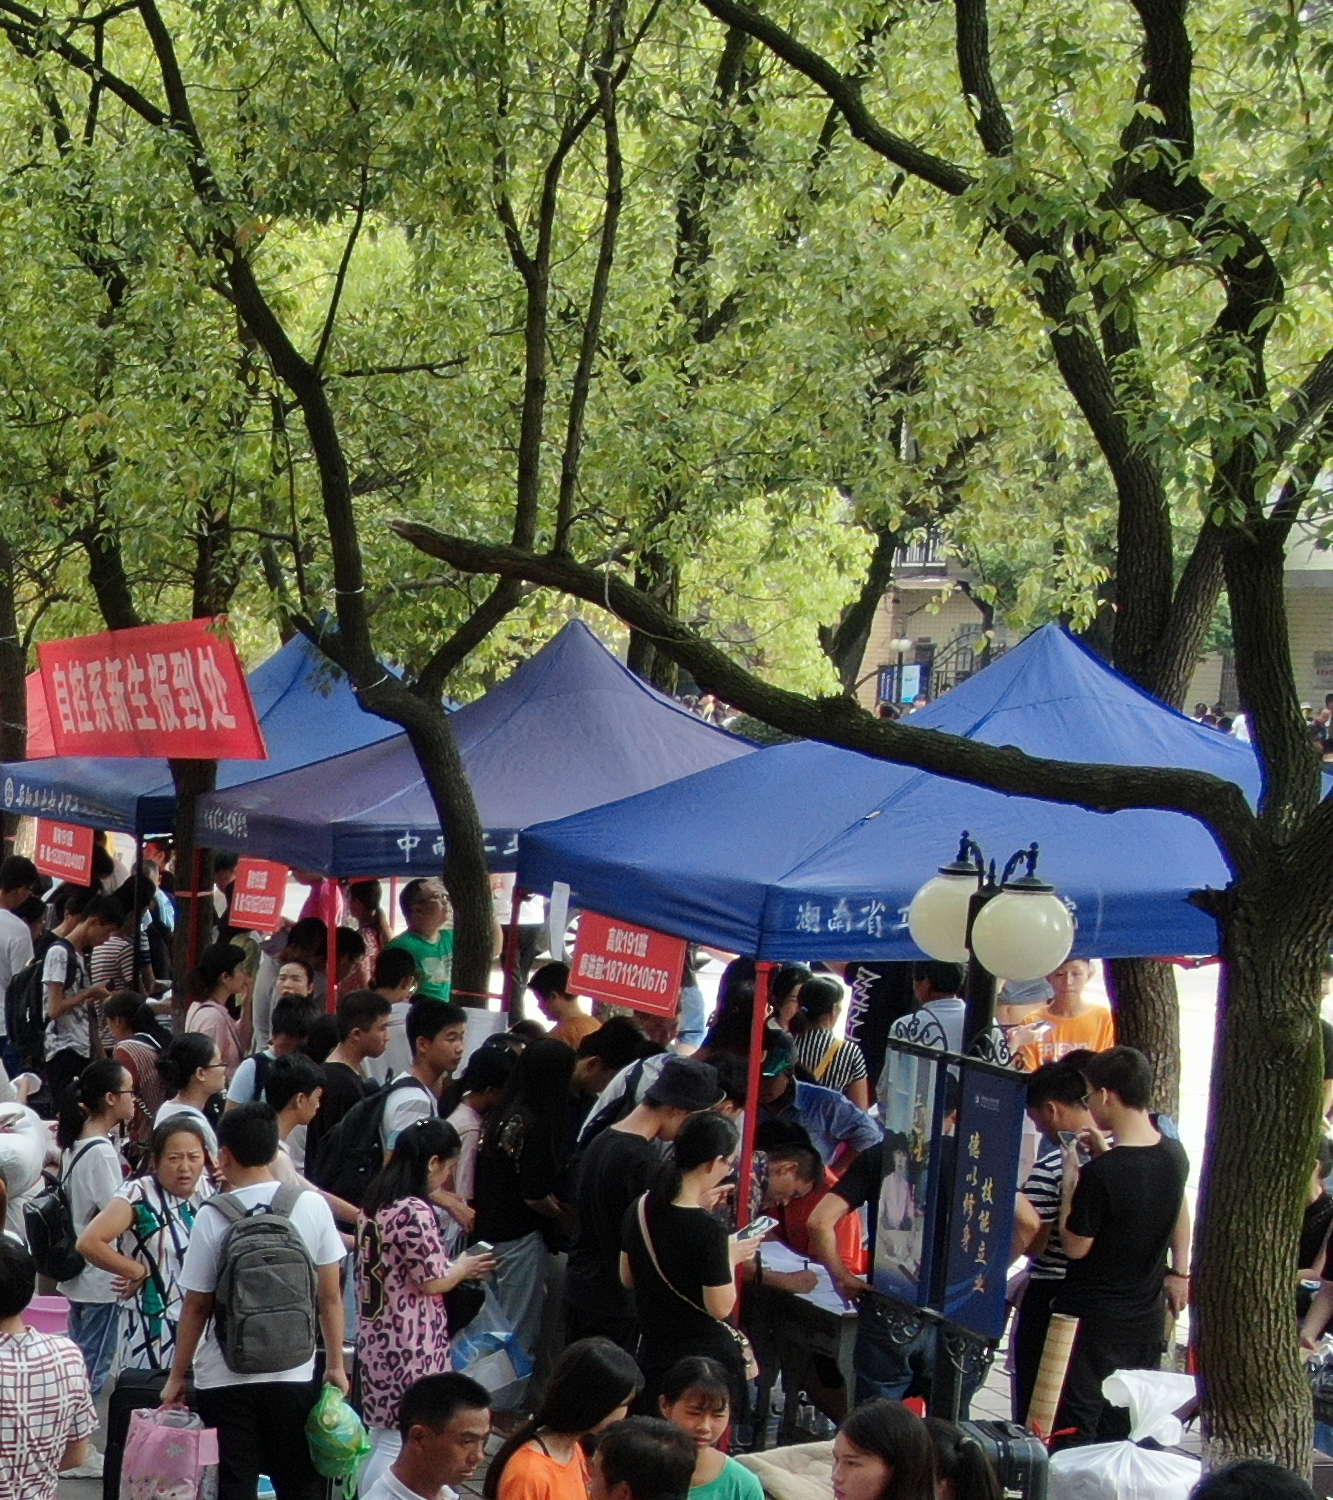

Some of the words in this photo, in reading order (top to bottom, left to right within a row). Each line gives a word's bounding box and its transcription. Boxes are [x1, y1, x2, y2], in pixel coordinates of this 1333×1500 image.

[53, 645, 236, 734] 自控系新生报到处
